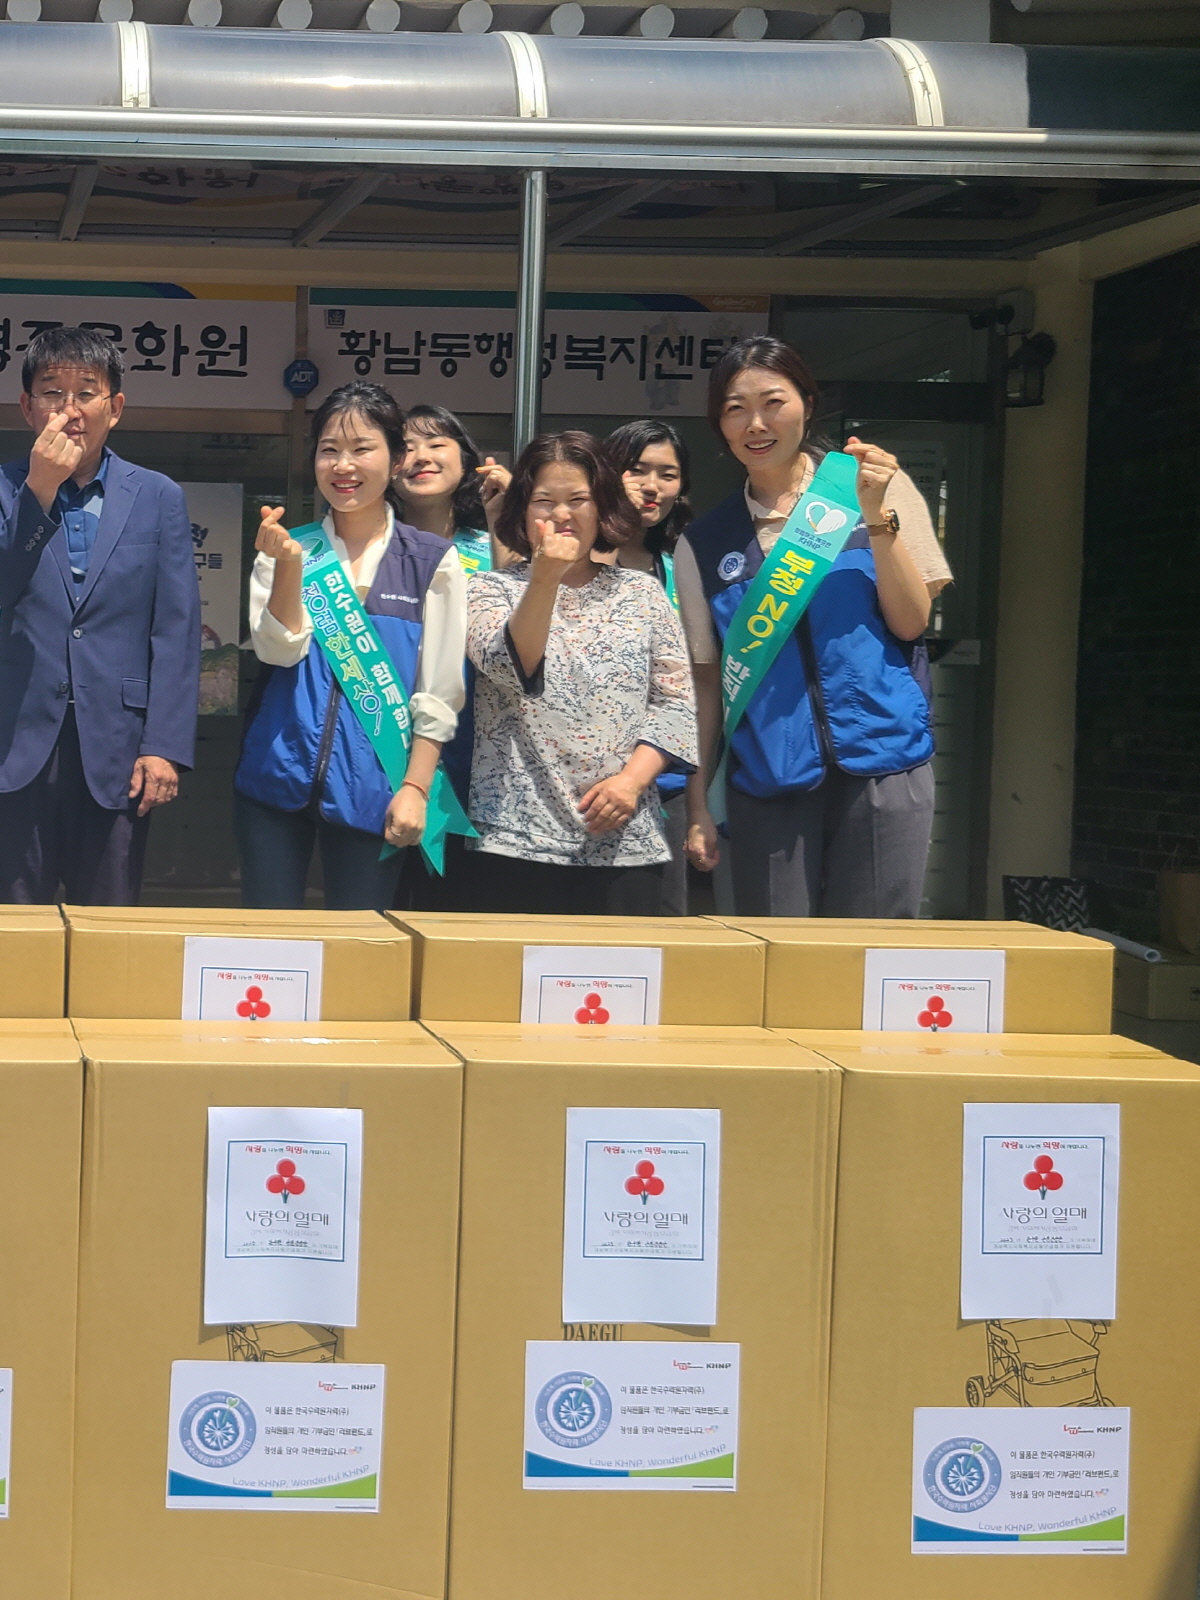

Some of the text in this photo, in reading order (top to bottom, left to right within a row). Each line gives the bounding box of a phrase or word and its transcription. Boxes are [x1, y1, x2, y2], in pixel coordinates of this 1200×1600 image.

[291, 371, 313, 383] ADT
[798, 537, 821, 550] KHNP
[302, 554, 325, 568] HNP
[323, 570, 379, 653] 한수원이
[301, 581, 383, 736] 청렴한세상!
[243, 1209, 329, 1231] 사랑의 열매
[601, 1208, 688, 1230] 사랑의 열매
[1000, 1204, 1087, 1225] 사랑의 열매
[563, 1324, 624, 1341] DAEGU
[351, 1383, 376, 1391] KHNP
[629, 1386, 648, 1395] 물품은
[650, 1385, 705, 1396] 한국수력원자력(주)
[274, 1407, 293, 1416] 물품은
[295, 1406, 350, 1417] 한국수력원자력(주)
[620, 1406, 650, 1415] 임직원들의
[653, 1406, 665, 1414] 개인
[667, 1406, 691, 1415] 기부금인
[265, 1426, 295, 1436] 임직원들의
[297, 1426, 309, 1435] 개인
[311, 1427, 335, 1436] 기부금인
[620, 1425, 639, 1435] 정성을
[642, 1425, 655, 1435] 담아
[264, 1445, 283, 1455] 정성을
[286, 1446, 299, 1455] 담아
[589, 1457, 613, 1468] Love
[649, 1452, 697, 1468] Wonderful
[700, 1443, 727, 1458] KHNP
[1019, 1451, 1038, 1460] 물품은
[1040, 1450, 1096, 1459] 한국수력원자력(주)
[233, 1477, 256, 1488] Love
[292, 1472, 340, 1489] Wonderful
[343, 1463, 370, 1479] KHNP
[1010, 1470, 1040, 1480] 임직원들의
[1042, 1470, 1055, 1478] 개인
[1057, 1470, 1081, 1479] 기부금인
[1009, 1490, 1028, 1499] 정성을
[1031, 1490, 1045, 1499] 담아
[978, 1522, 1002, 1532] Love
[1039, 1515, 1087, 1531] Wonderful
[1090, 1506, 1117, 1521] KHNP
